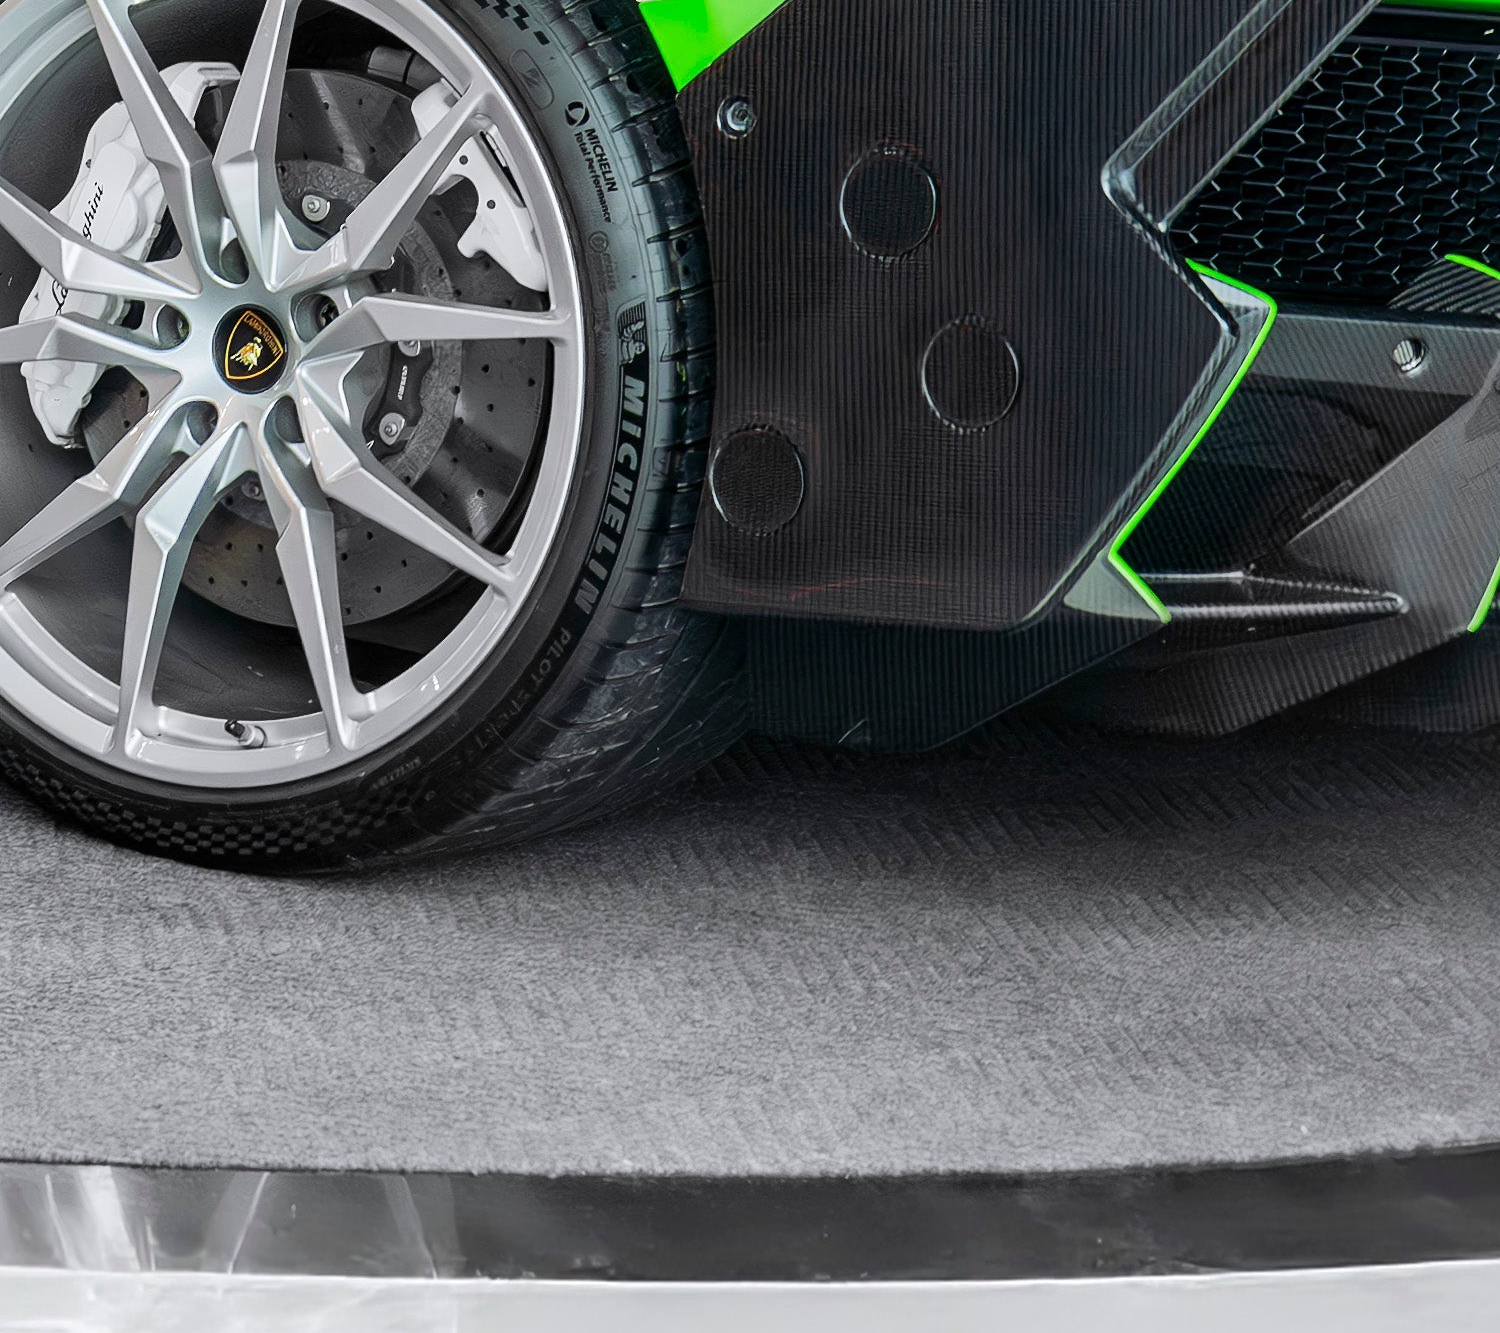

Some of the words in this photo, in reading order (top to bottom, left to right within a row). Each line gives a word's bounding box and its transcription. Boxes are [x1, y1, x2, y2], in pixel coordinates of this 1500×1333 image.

[574, 131, 592, 161] Total
[584, 159, 612, 224] Performance
[585, 127, 619, 193] MICHELIN
[574, 374, 646, 616] MICHELIN
